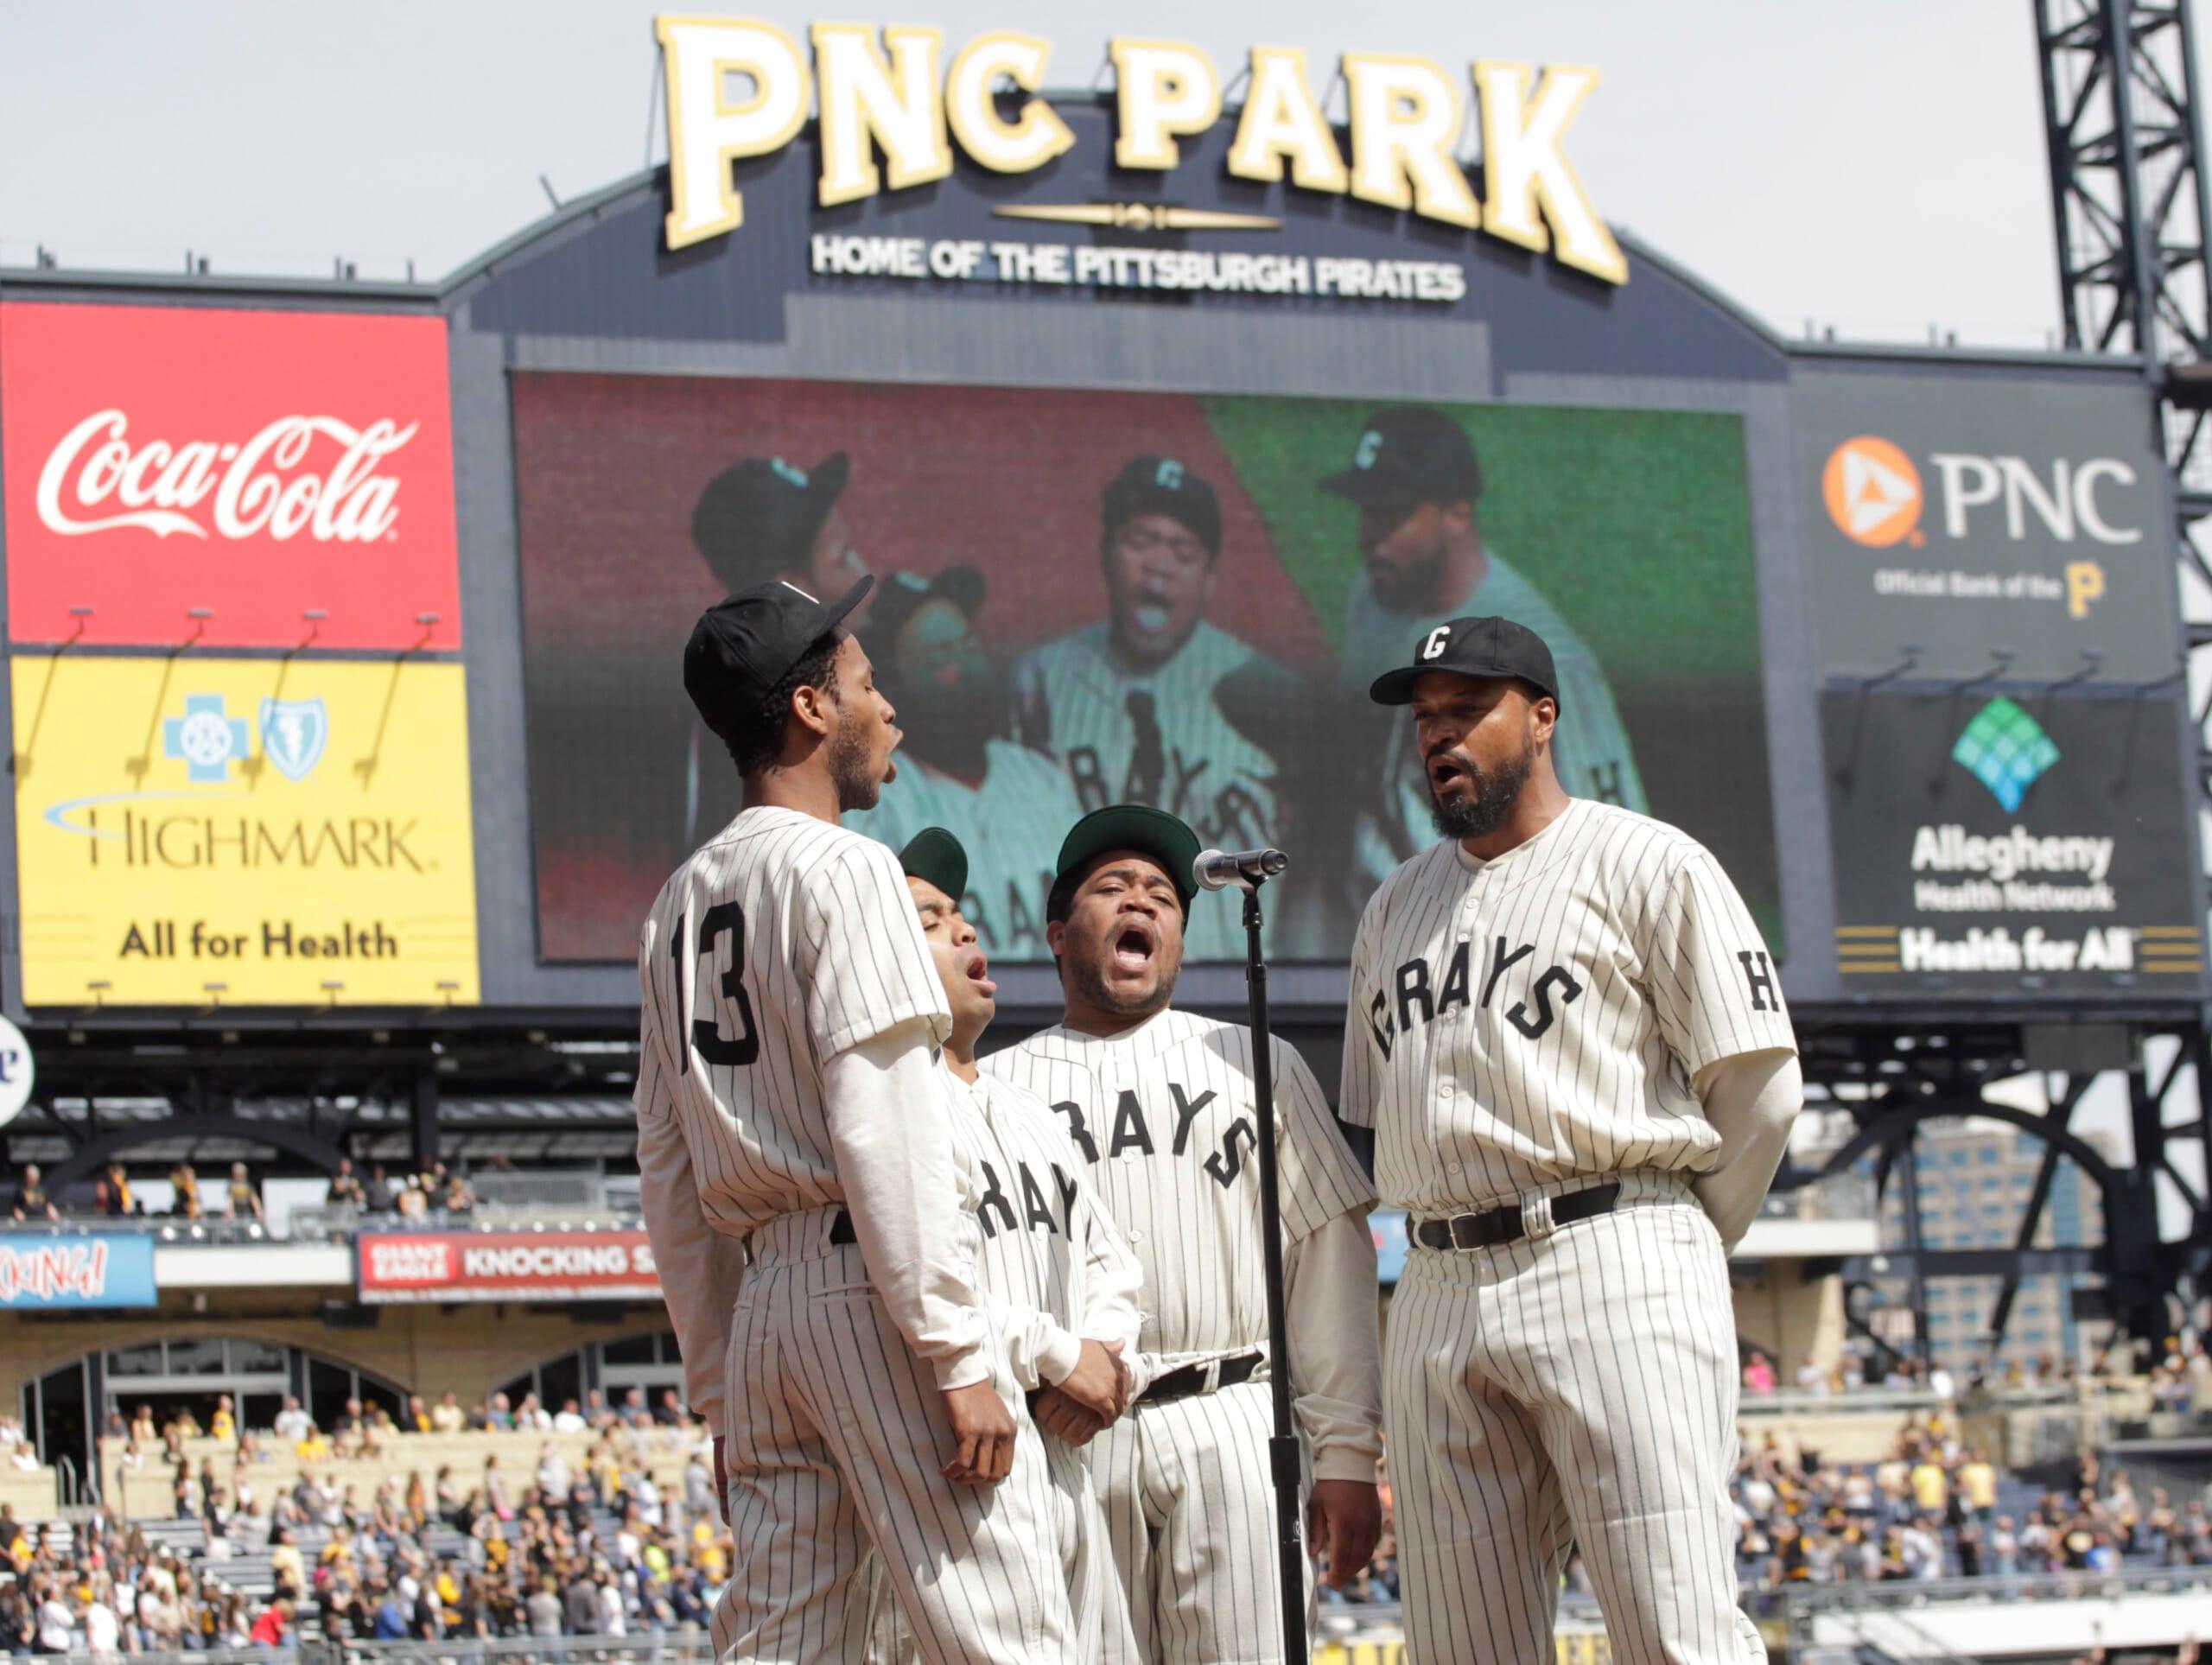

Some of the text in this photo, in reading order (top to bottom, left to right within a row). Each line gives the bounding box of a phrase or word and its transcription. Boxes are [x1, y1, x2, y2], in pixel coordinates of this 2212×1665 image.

[656, 14, 1629, 286] PNC PARK
[810, 234, 1466, 302] HOME OF THE PITTSBURGH PIRATES
[1930, 452, 2143, 545] PNC
[1948, 570, 2001, 598] Bank
[2004, 571, 2027, 599] of
[2029, 572, 2064, 601] the
[1423, 626, 1451, 659] G
[87, 807, 424, 874] HIGHMARK
[1911, 823, 2114, 882] Allegheny
[1914, 879, 2115, 912] Health Network
[118, 920, 398, 960] All for Health
[1900, 926, 2134, 971] Health for All
[671, 900, 760, 1077] 13
[1371, 936, 1583, 1062] GRAYS
[1737, 950, 1779, 1012] H
[1049, 1083, 1257, 1189] RAYS
[976, 1160, 1091, 1249] RAY
[370, 1242, 449, 1262] GIANT
[372, 1261, 448, 1281] EAGLE
[463, 1244, 628, 1277] KNOCKING
